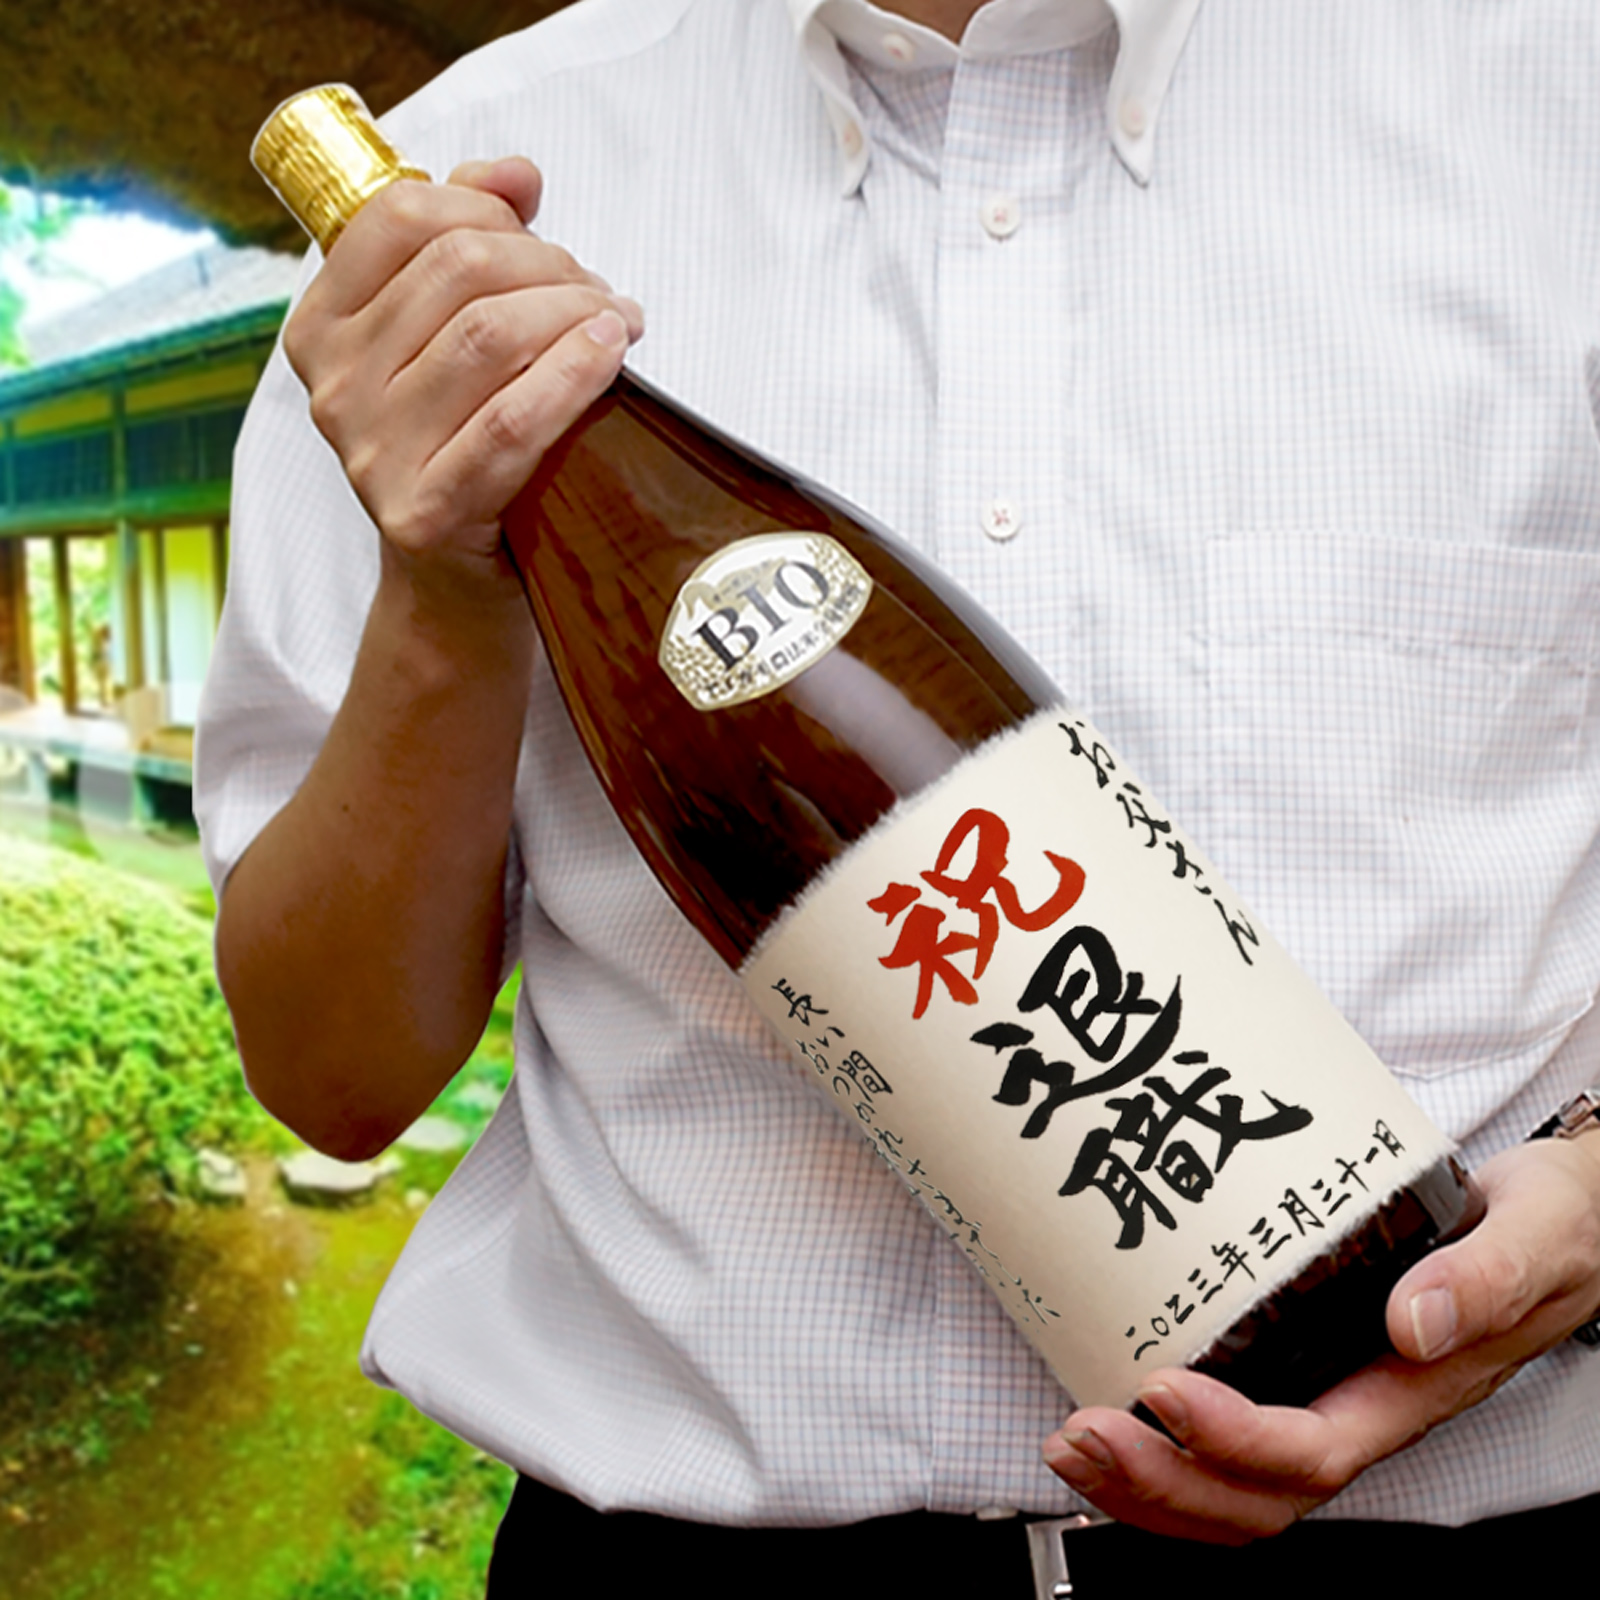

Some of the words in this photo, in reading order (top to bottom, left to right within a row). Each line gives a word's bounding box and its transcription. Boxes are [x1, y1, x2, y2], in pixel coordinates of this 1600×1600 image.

[690, 559, 830, 673] BIO
[866, 808, 1086, 1020] 祝
[1058, 722, 1260, 967] お父さん
[771, 977, 893, 1103] 長い間
[972, 925, 1313, 1250] 退職
